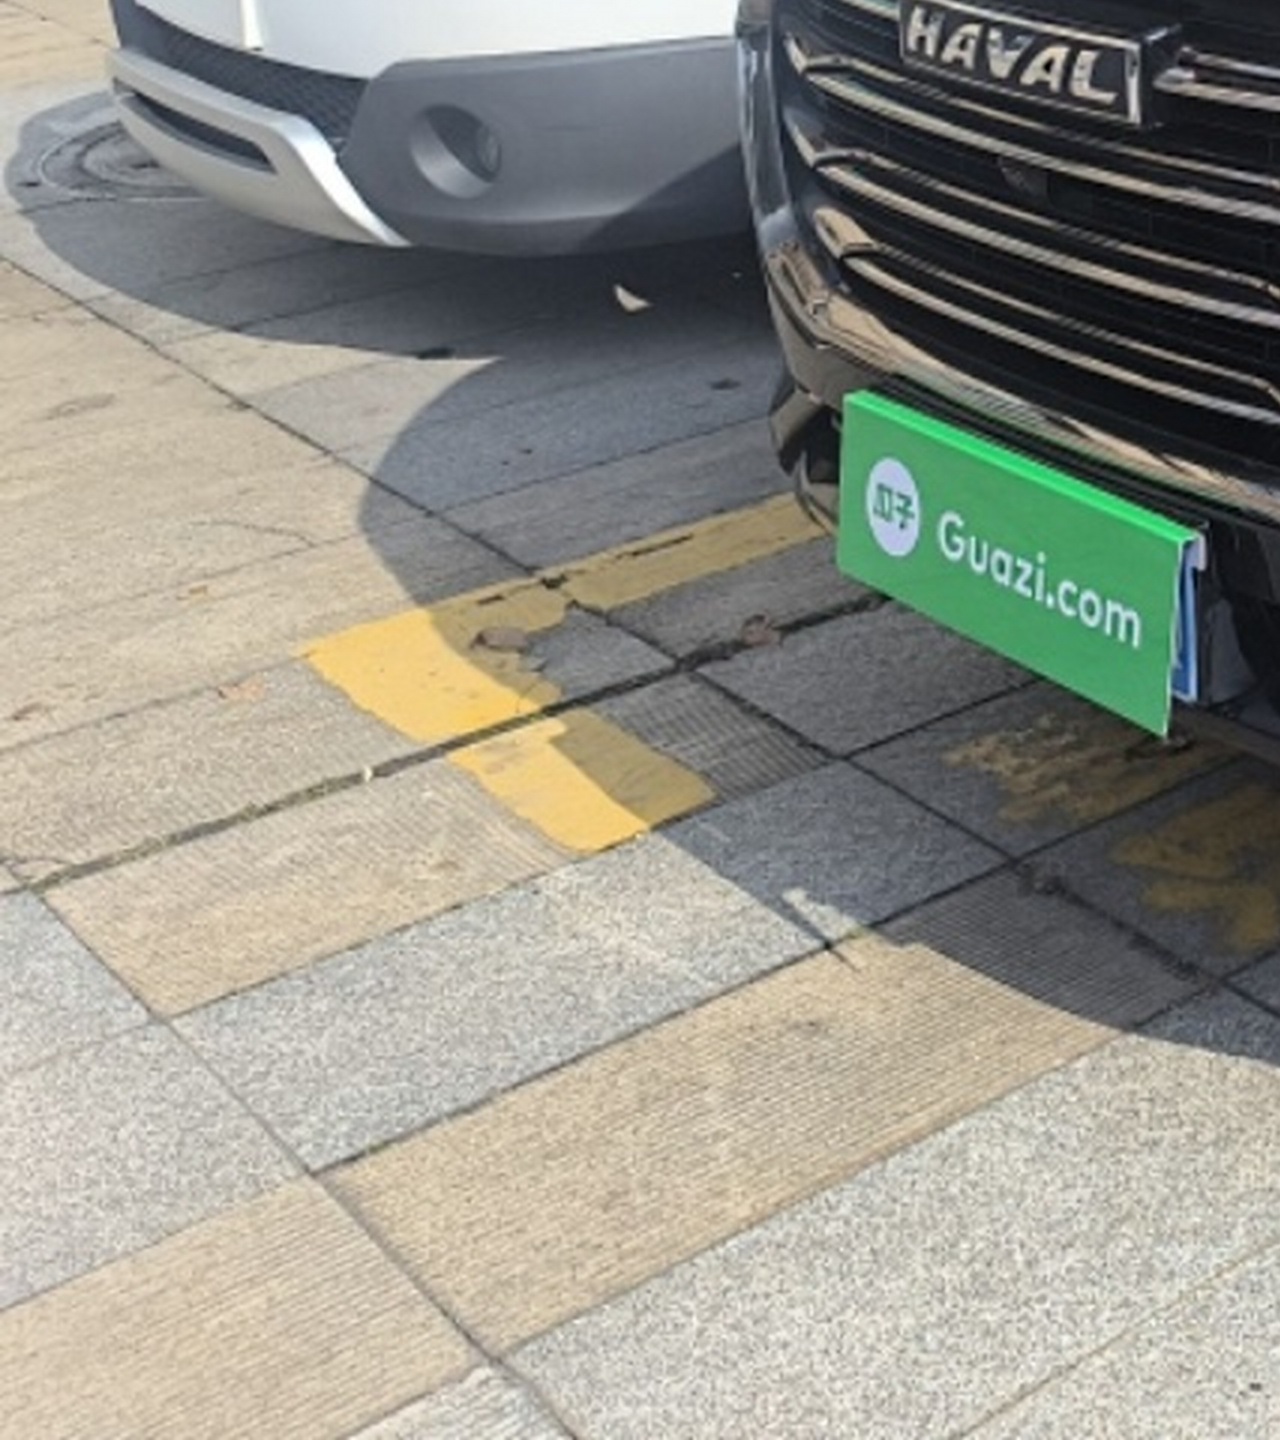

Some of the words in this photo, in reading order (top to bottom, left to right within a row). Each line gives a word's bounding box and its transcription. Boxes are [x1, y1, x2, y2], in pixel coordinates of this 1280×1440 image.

[906, 5, 1118, 105] HAVAL
[873, 482, 915, 529] 瓜子
[937, 510, 1142, 650] Guazi.com
